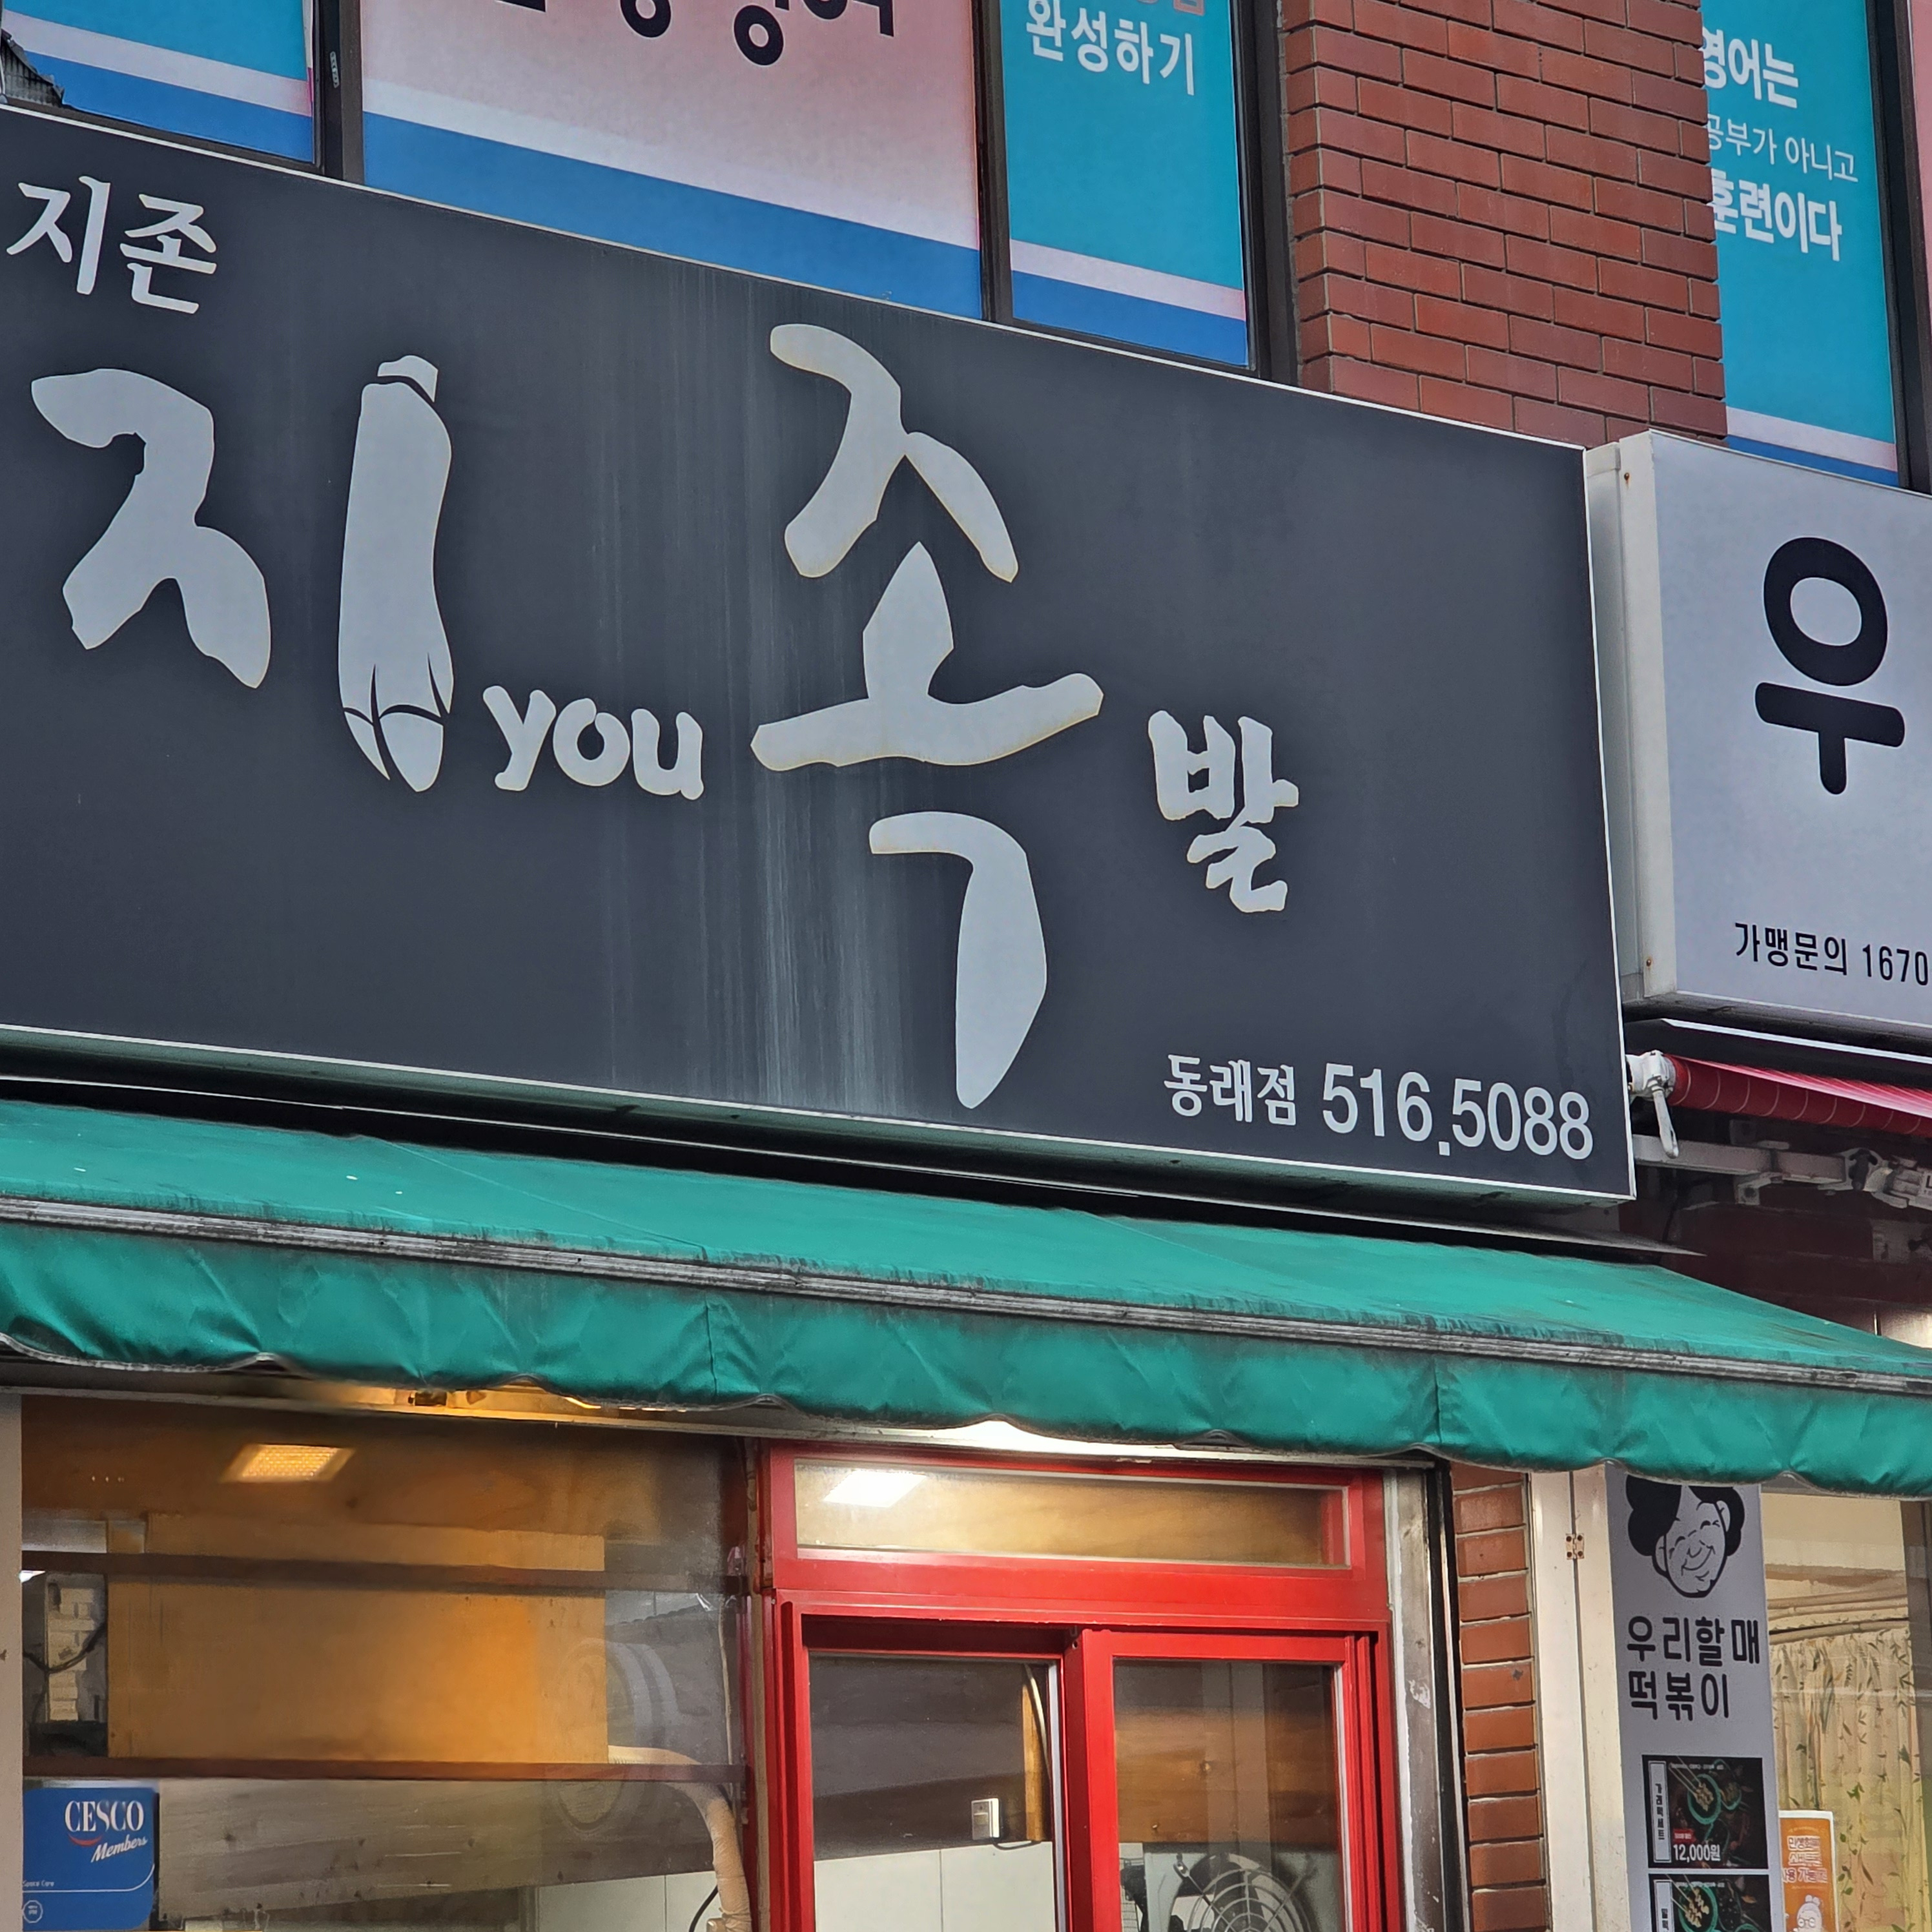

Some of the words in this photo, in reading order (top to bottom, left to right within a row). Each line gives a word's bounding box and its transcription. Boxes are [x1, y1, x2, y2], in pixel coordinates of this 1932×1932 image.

[1026, 0, 1195, 96] 완성하기
[1785, 137, 1858, 183] 아니고
[6, 176, 217, 314] 지존
[1754, 537, 1905, 796] 우
[1735, 923, 1847, 976] 가맹문의
[1863, 944, 1929, 986] 1670
[1164, 1054, 1297, 1126] 동래점
[1322, 1063, 1594, 1160] 516.5088
[1627, 1616, 1760, 1667] 우리할매
[1628, 1670, 1729, 1721] 떡볶이
[65, 1800, 144, 1832] CESCO
[90, 1834, 149, 1863] Members
[1673, 1844, 1721, 1863] 12,000원
